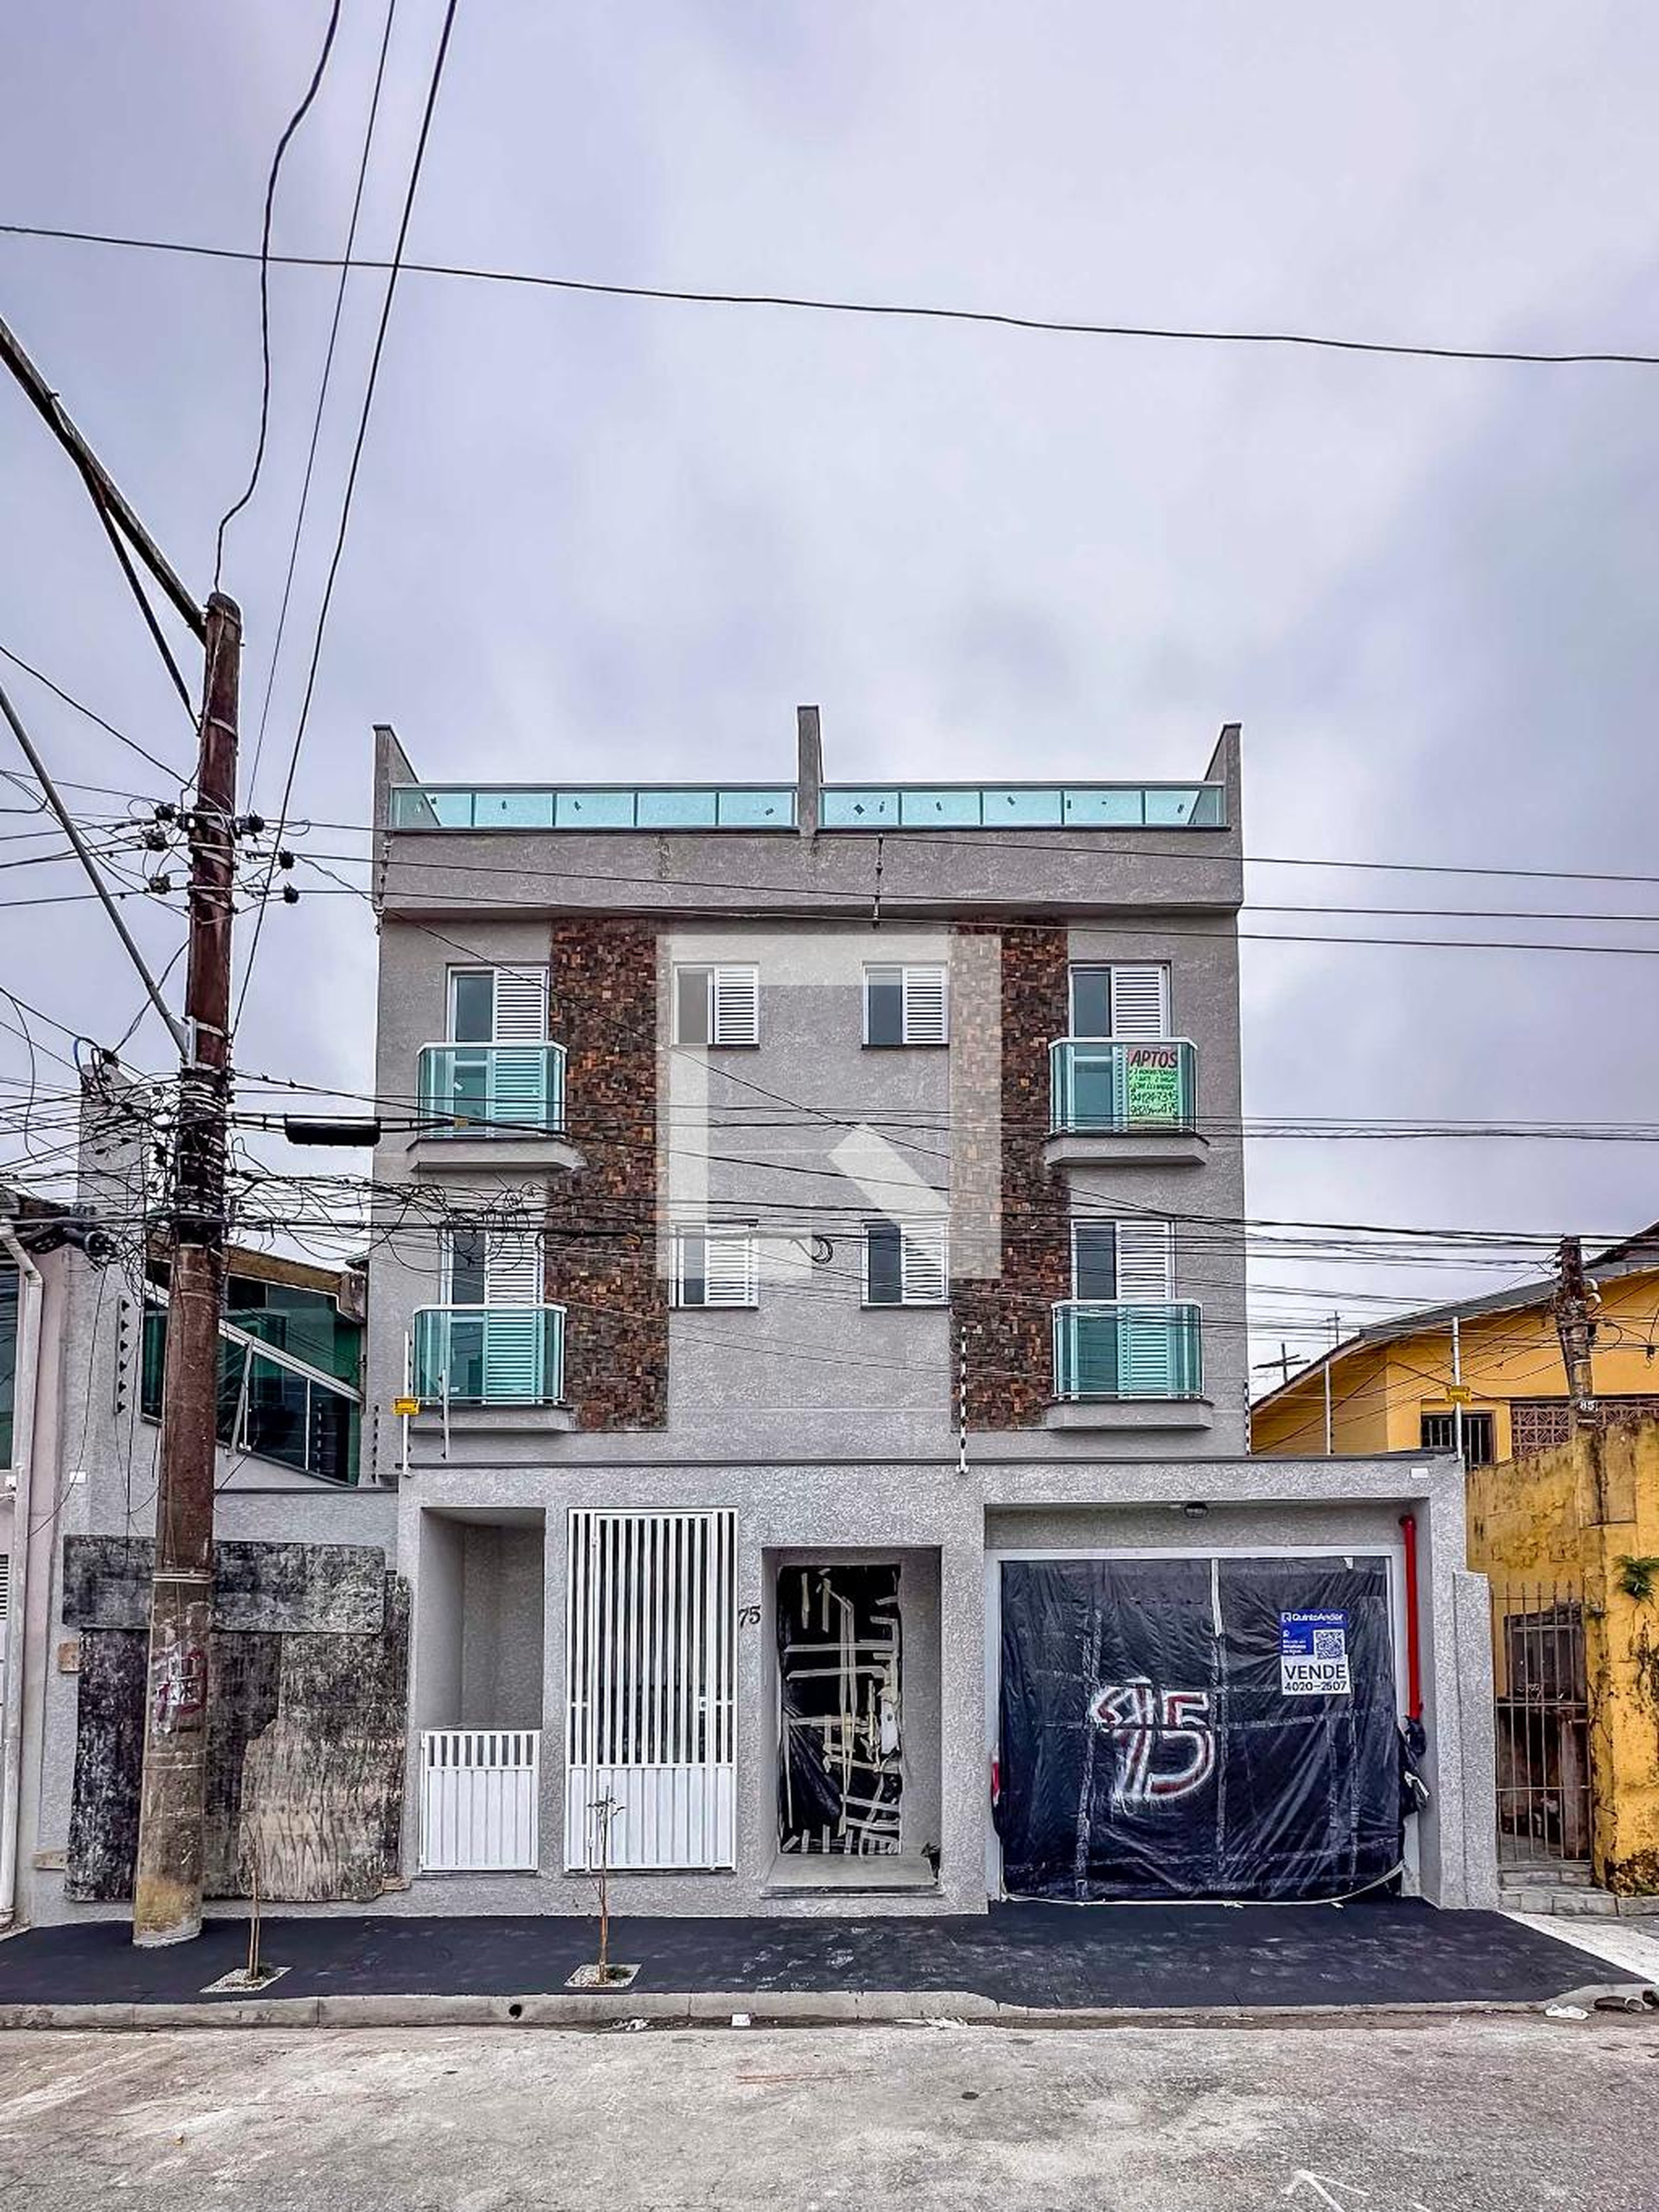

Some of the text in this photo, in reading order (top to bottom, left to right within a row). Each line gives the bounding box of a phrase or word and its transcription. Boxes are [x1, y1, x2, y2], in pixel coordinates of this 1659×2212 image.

[1130, 1050, 1178, 1068] APTOS
[738, 1604, 761, 1628] 75
[1284, 1665, 1346, 1679] VENDE
[1284, 1681, 1346, 1691] 4020-2507
